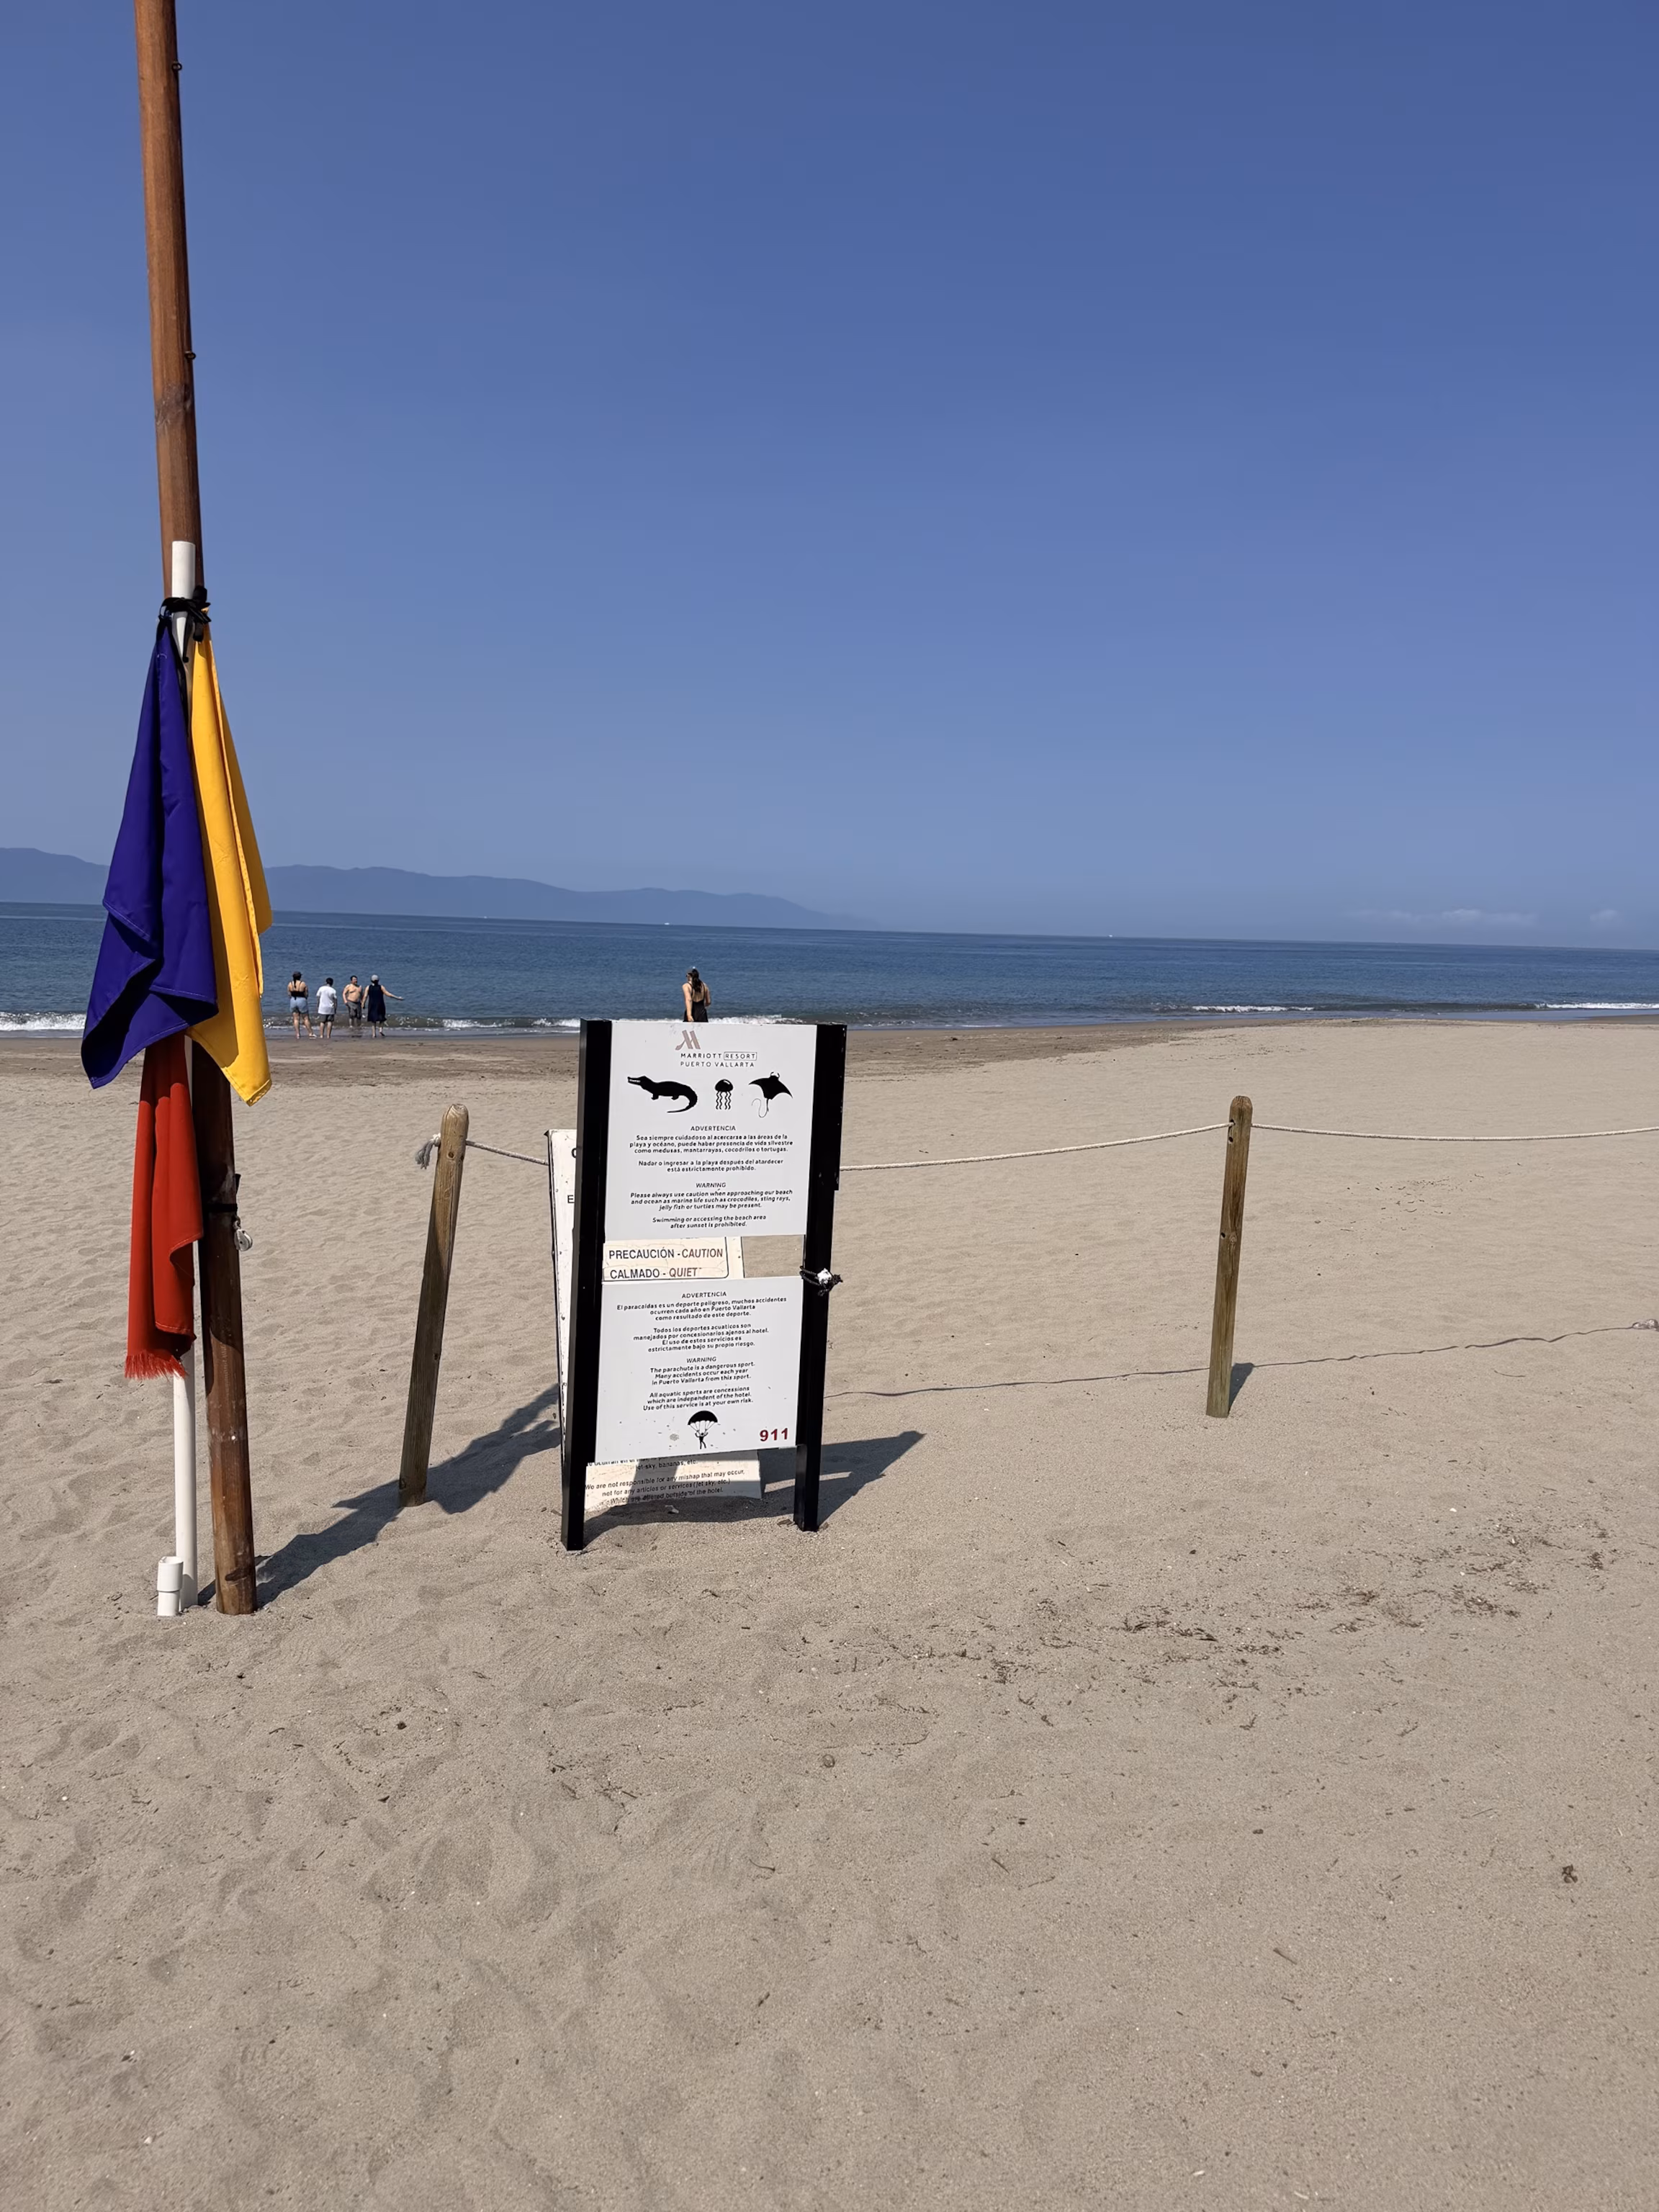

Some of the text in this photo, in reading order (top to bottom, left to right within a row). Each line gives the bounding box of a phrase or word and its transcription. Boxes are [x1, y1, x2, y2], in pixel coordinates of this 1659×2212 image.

[609, 1247, 723, 1260] PRECAUCIÓN CAUTION
[610, 1267, 698, 1279] CALMADO QUIET
[760, 1427, 788, 1442] 911
